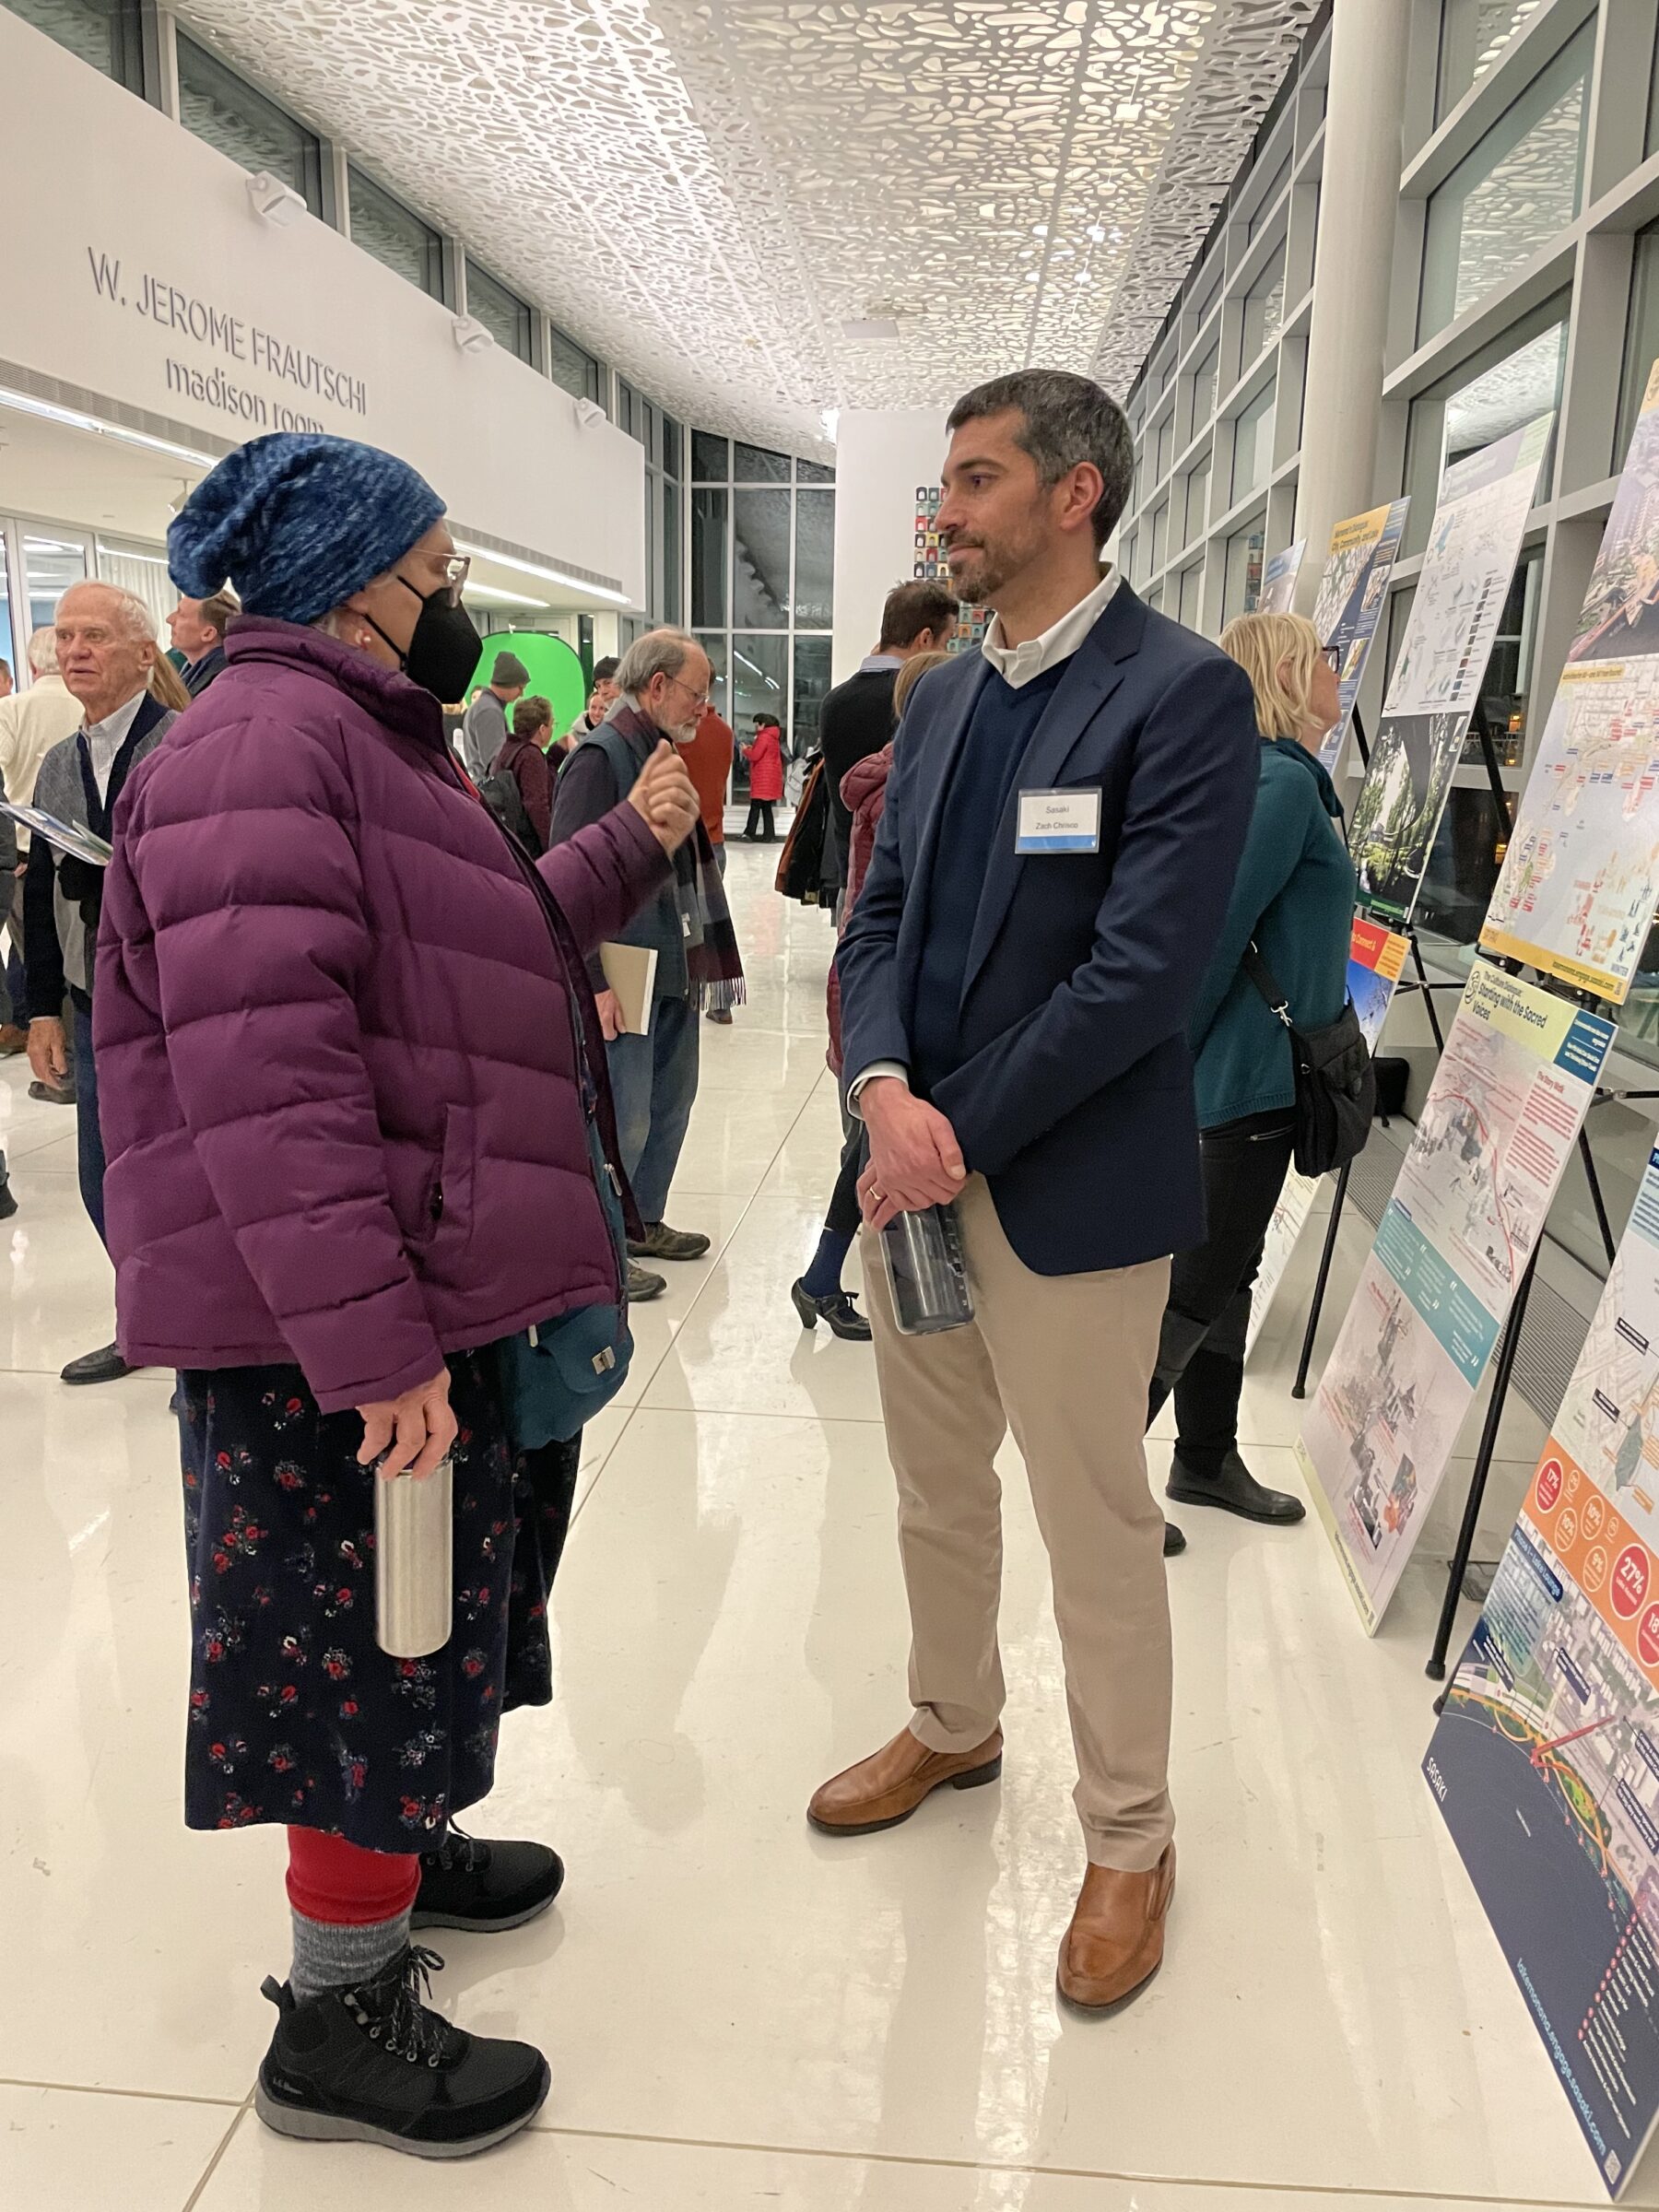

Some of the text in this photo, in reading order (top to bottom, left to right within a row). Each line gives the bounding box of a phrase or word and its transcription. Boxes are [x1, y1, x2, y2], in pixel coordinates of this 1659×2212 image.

[88, 245, 367, 417] W. JEROME FRAUTSCHI
[166, 358, 267, 427] madison
[1045, 806, 1070, 814] Sasaki
[1472, 1002, 1491, 1021] Voices
[1477, 982, 1548, 1029] Starting with the Sacred
[1514, 1529, 1527, 1551] Phase
[1532, 1555, 1544, 1574] Lake
[1542, 1568, 1560, 1597] Lounge
[1620, 1555, 1645, 1594] 27%
[1647, 1612, 1659, 1639] 18
[1426, 1756, 1448, 1803] SASAKI
[1516, 1958, 1606, 2156] lakemonona.engage.sasaki.com
